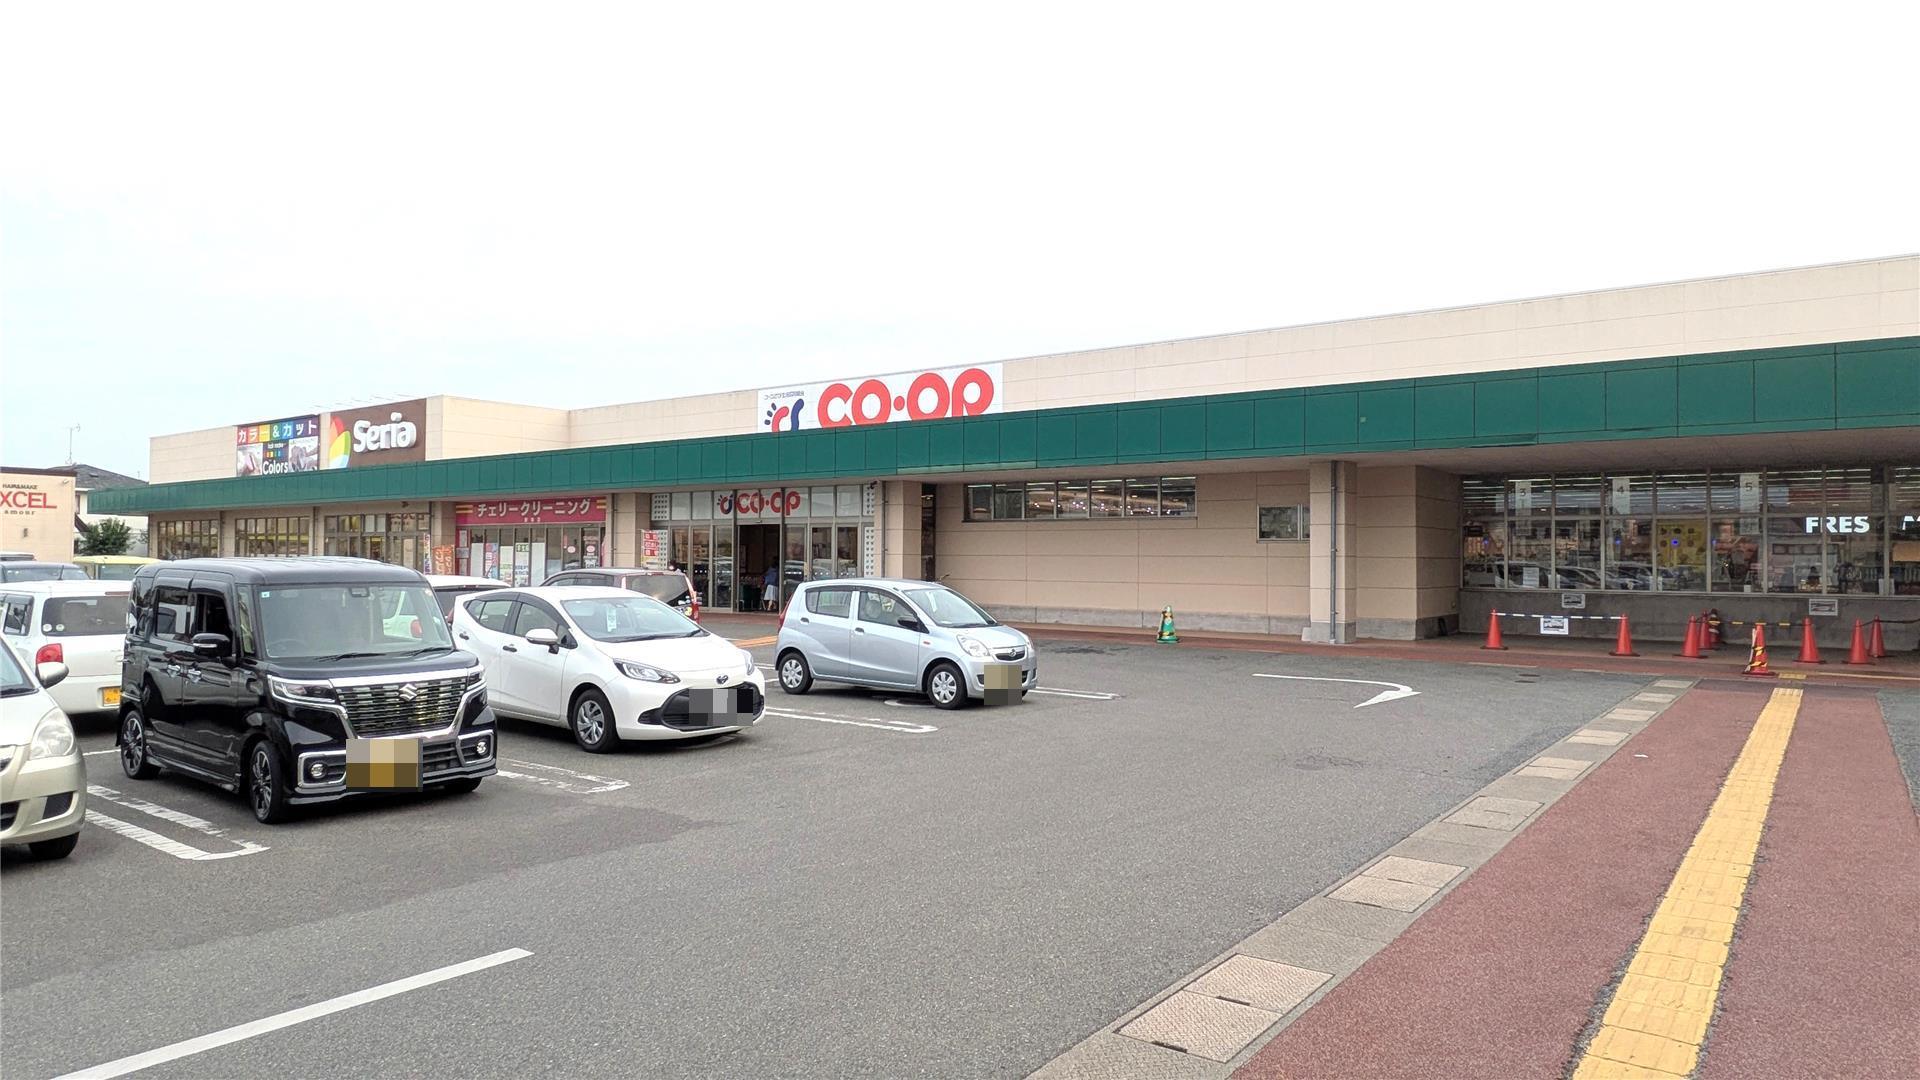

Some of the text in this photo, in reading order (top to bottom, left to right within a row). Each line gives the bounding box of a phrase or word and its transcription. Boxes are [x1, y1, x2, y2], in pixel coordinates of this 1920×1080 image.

[353, 412, 417, 453] Seria
[262, 459, 289, 475] Colors
[1519, 488, 1527, 497] 3
[1616, 485, 1625, 495] 4
[1745, 482, 1753, 492] 5
[477, 498, 591, 518] チェリークリーニング
